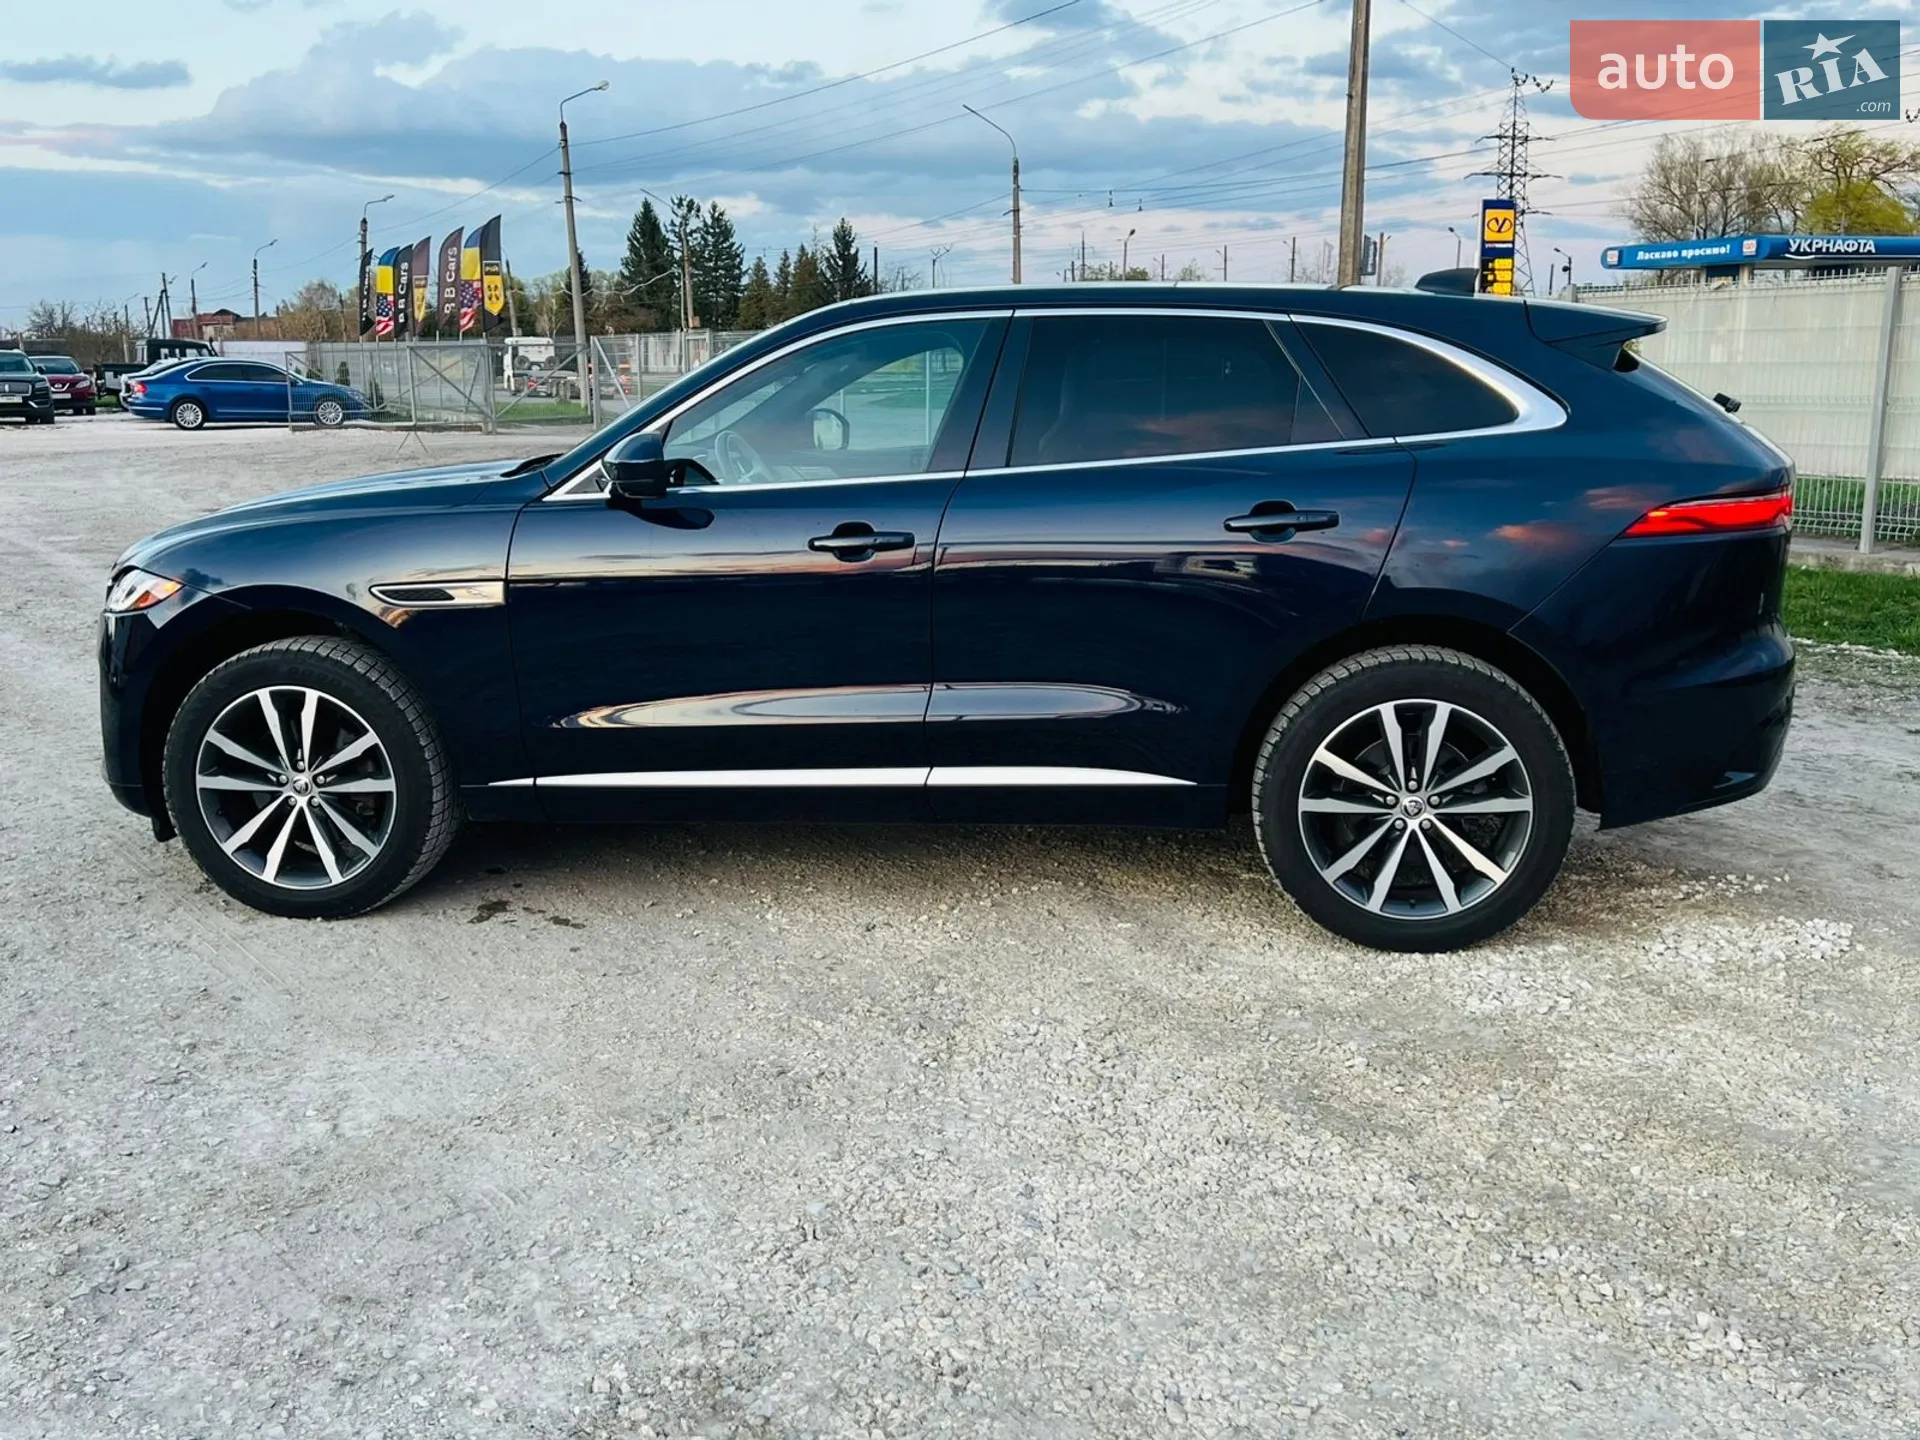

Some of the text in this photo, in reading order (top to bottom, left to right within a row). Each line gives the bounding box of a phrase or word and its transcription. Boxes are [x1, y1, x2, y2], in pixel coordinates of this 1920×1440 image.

[1788, 238, 1876, 254] УКРНАФТА
[398, 261, 409, 294] Cars
[445, 246, 458, 283] Cars
